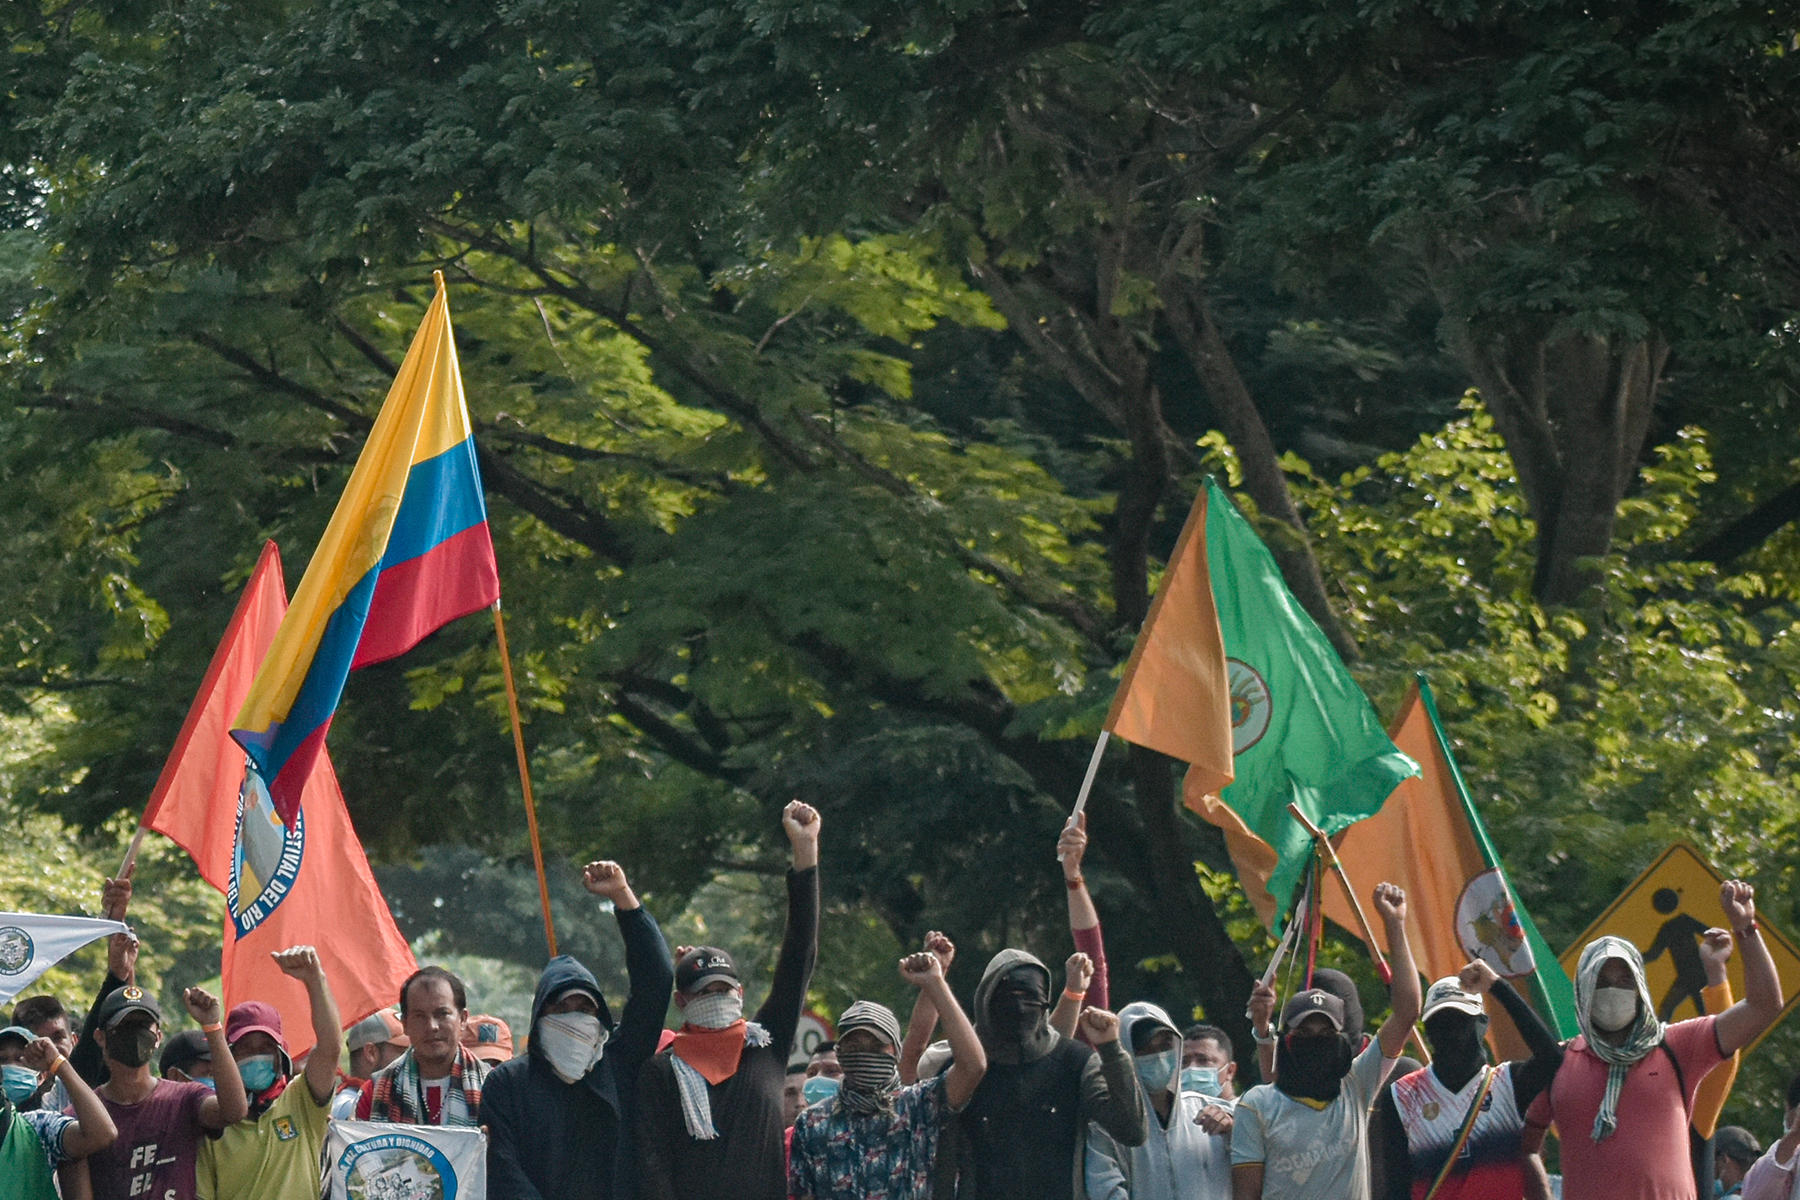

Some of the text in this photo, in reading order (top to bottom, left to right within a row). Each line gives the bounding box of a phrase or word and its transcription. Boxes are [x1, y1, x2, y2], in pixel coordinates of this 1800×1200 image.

[259, 879, 287, 909] DEL
[241, 903, 264, 930] RÍO
[792, 1029, 822, 1056] 0
[388, 1137, 395, 1147] Y
[396, 1137, 436, 1159] DIGNIDAD
